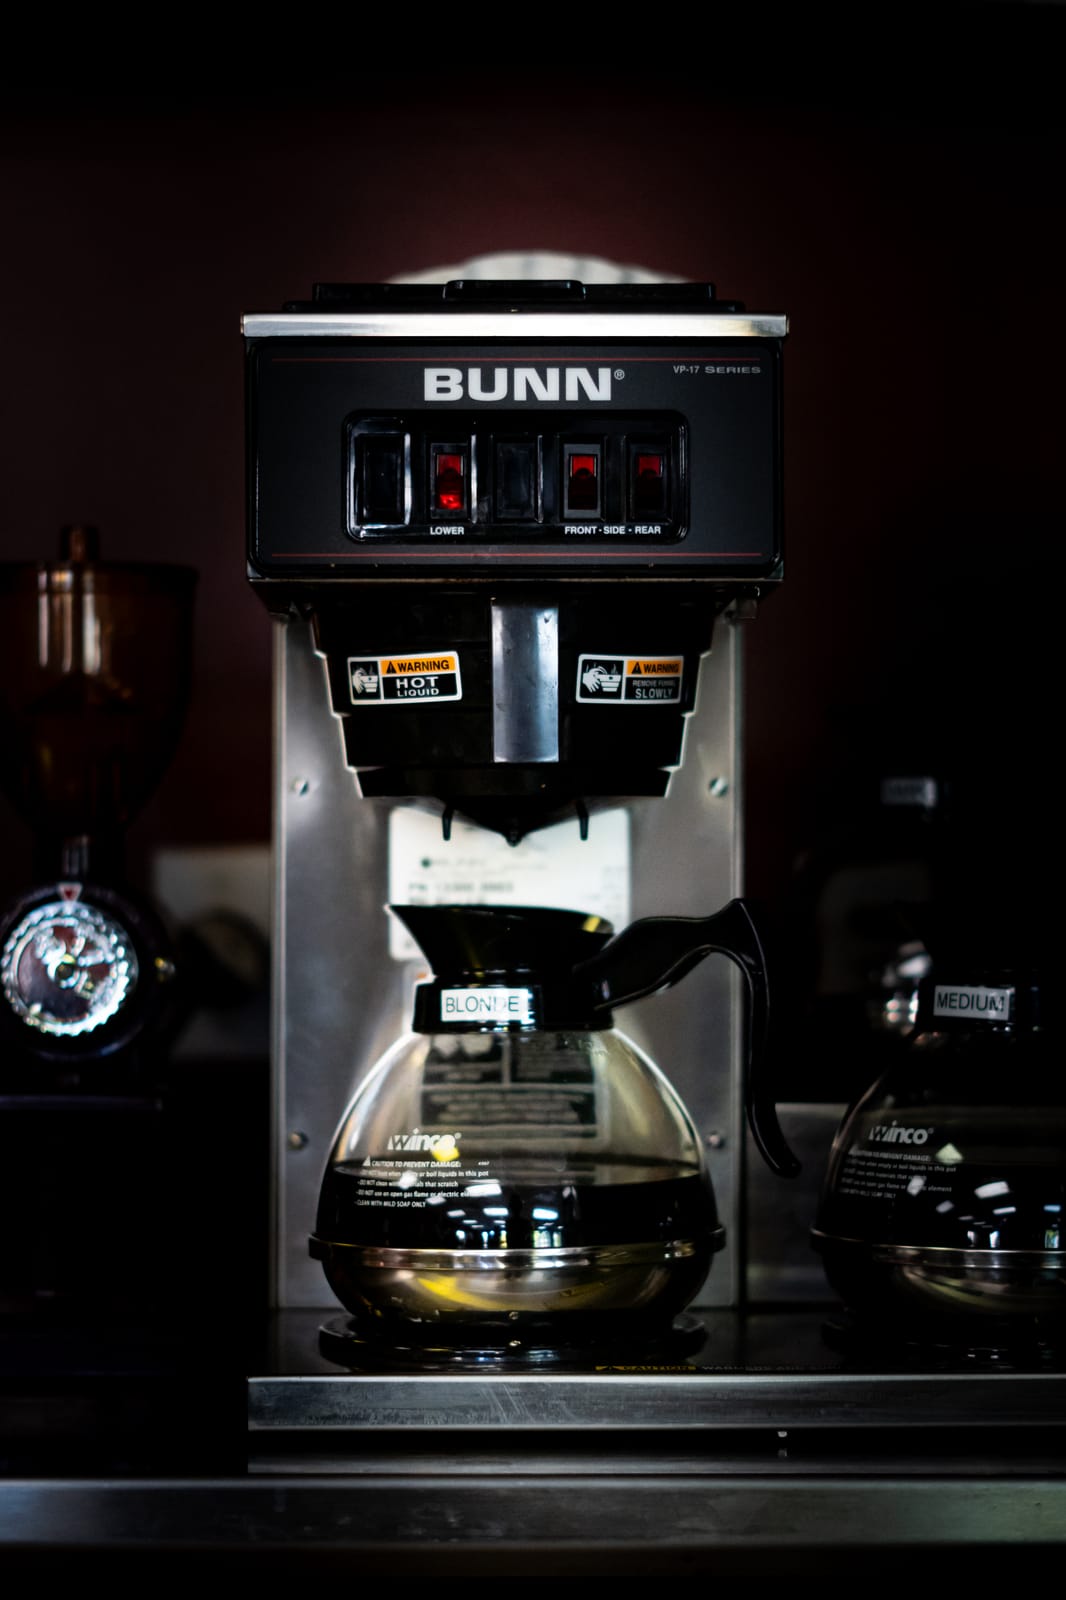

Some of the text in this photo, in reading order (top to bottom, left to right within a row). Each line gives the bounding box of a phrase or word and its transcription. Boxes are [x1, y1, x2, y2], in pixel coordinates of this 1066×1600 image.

[673, 365, 700, 374] VP-17
[424, 367, 612, 402] BUNN
[430, 526, 465, 535] LOWER
[564, 526, 661, 535] FRONT SIDE REAR
[397, 660, 450, 673] WARNING
[643, 663, 679, 674] WARNING
[396, 676, 439, 689] HOT
[397, 688, 440, 697] LIQUID
[635, 688, 673, 699] SLOWLY
